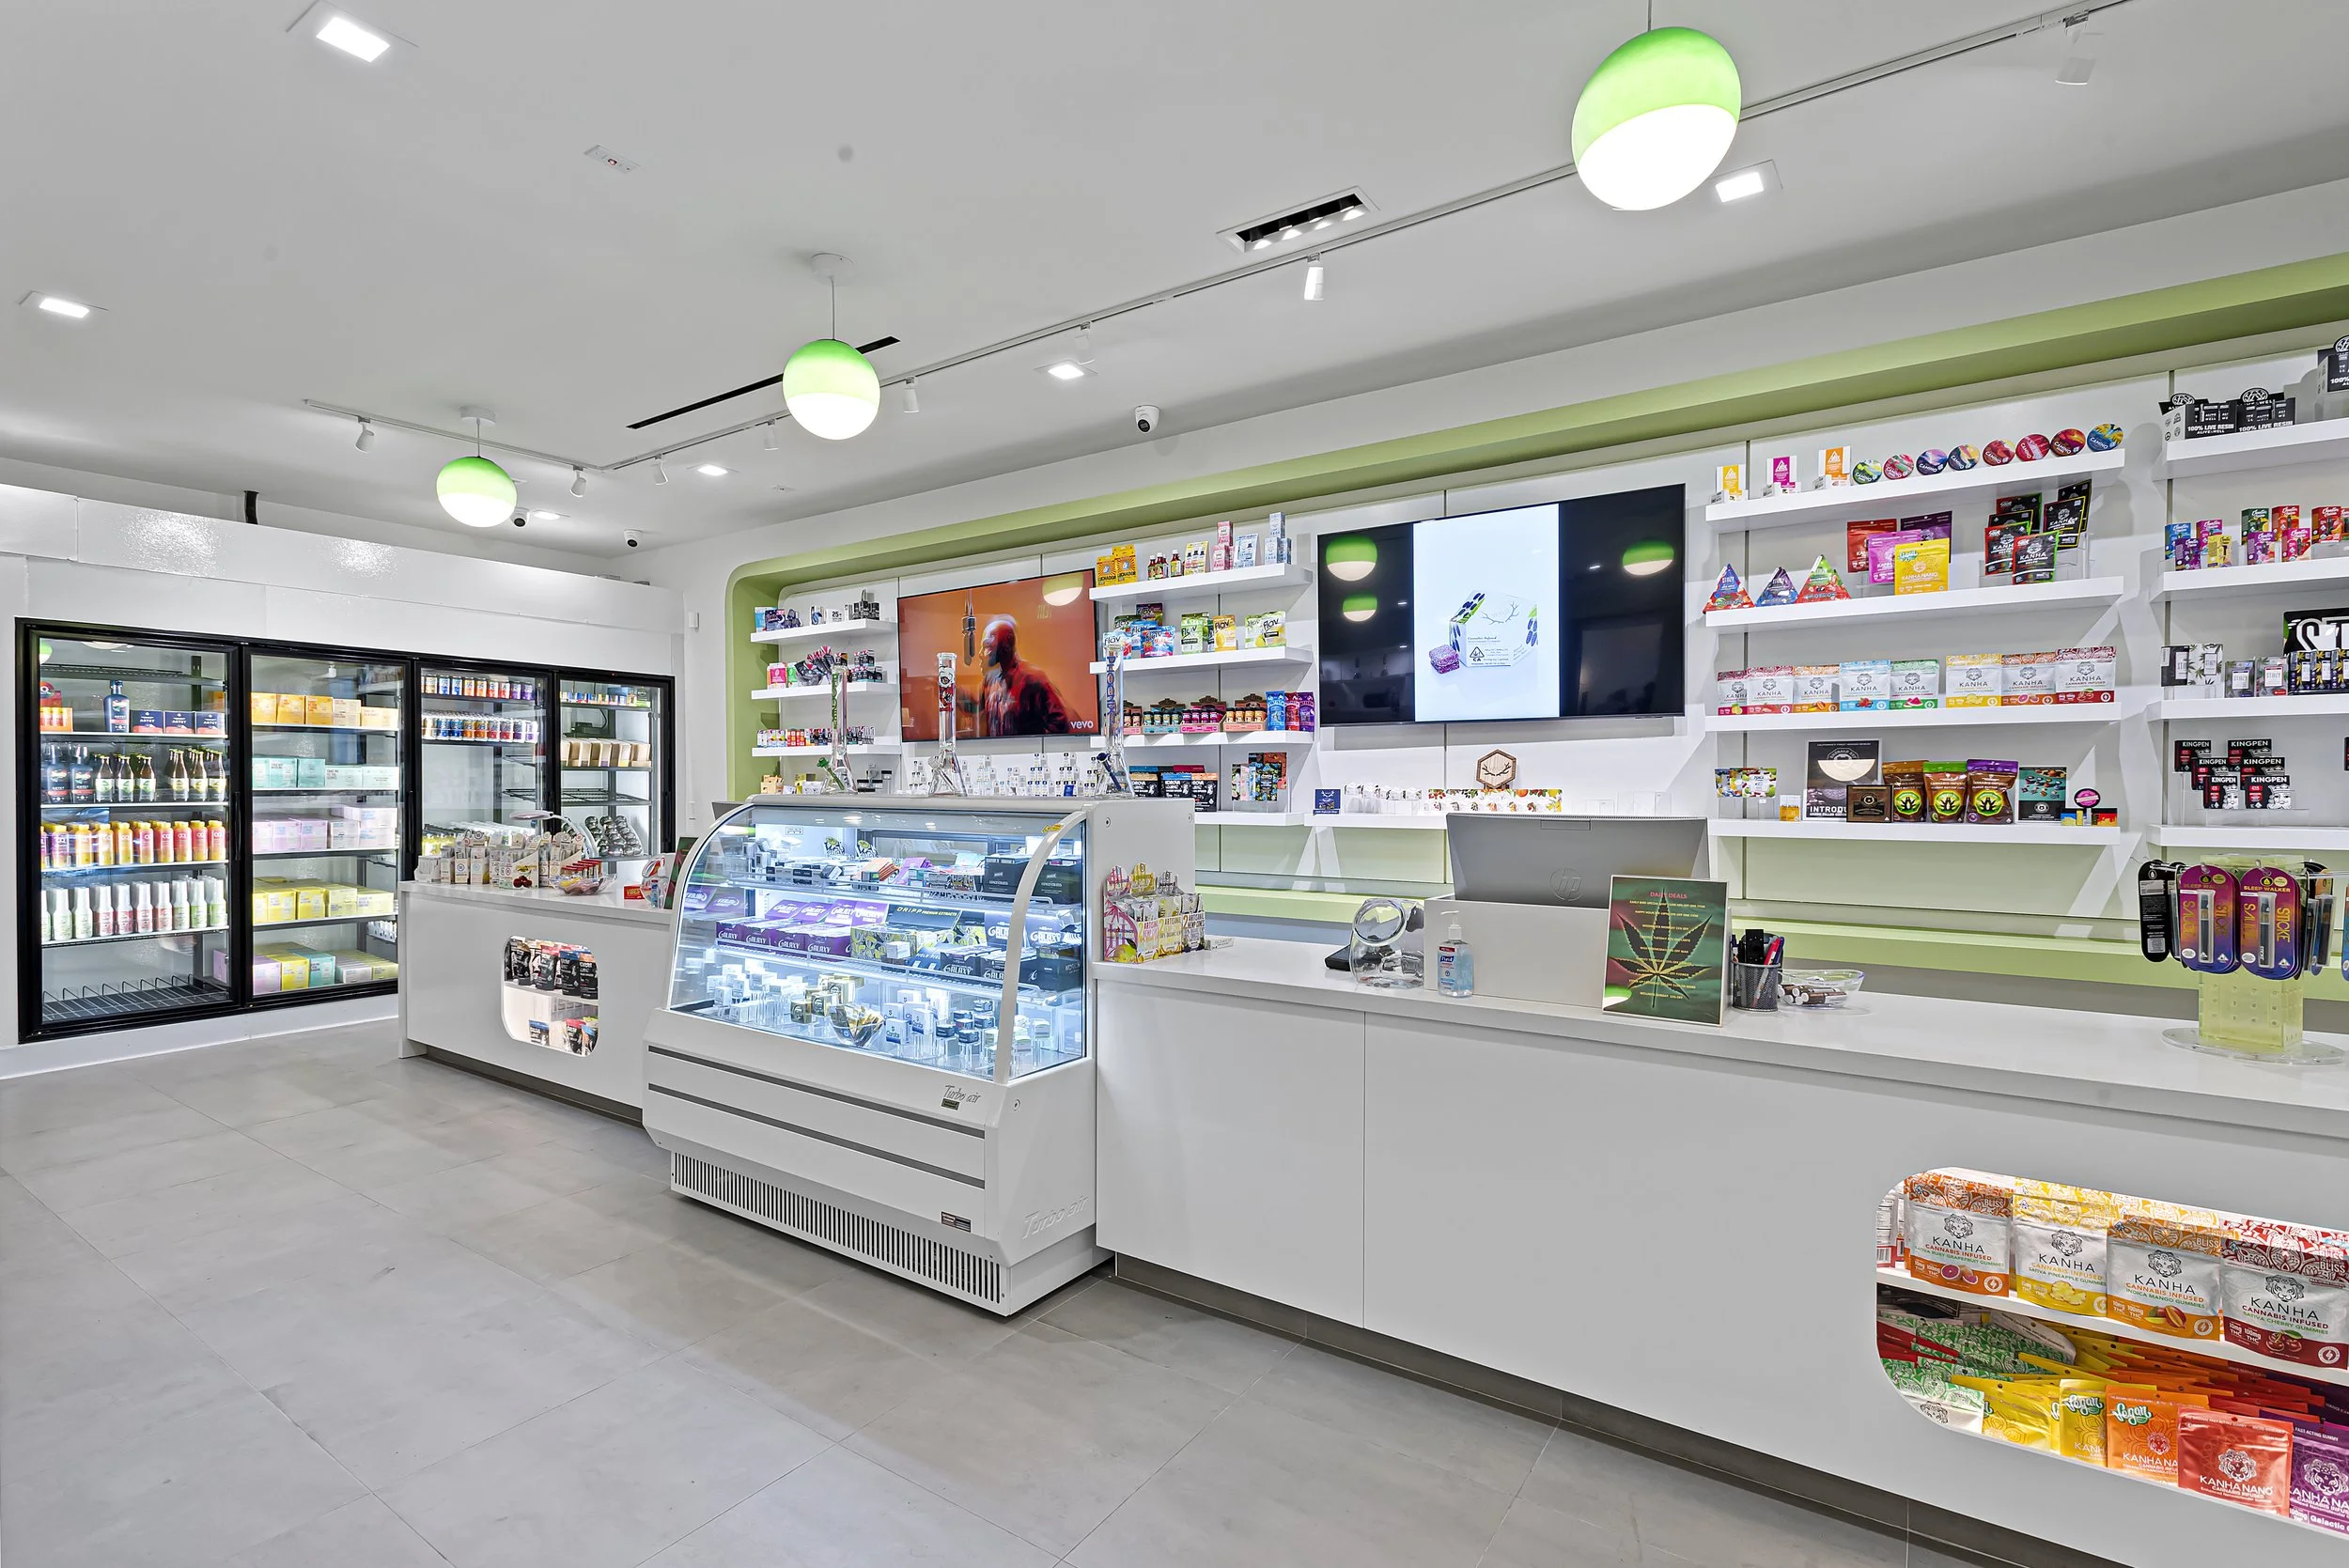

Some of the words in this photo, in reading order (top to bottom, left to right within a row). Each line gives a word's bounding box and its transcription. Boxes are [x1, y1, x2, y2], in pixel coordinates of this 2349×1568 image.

[2020, 442, 2031, 458] CAMINO
[2054, 442, 2072, 455] CAMINO
[2090, 437, 2108, 449] CAMINO
[1951, 455, 1965, 469] CAMINO
[1984, 451, 2001, 464] CAMINO
[1919, 464, 1937, 473] CAMINO
[1855, 472, 1873, 482] CAMINO
[1069, 720, 1094, 730] vevo
[988, 926, 1009, 939] GALA
[2277, 908, 2291, 943] STICKE
[718, 930, 739, 939] GALAXY
[778, 939, 801, 949] GALAXY
[807, 943, 832, 953] GALAXY
[943, 964, 972, 975] GALAXY
[985, 970, 1004, 980] GALA
[943, 1084, 966, 1101] Turbo
[966, 1093, 981, 1104] air
[1983, 1198, 2004, 1209] BLISS
[1022, 1211, 1066, 1240] Turbo
[1067, 1195, 1089, 1218] air
[1932, 1235, 1985, 1254] KANHA
[2197, 1237, 2219, 1249] BLISS
[1924, 1244, 1960, 1257] CANNABIS
[1961, 1250, 1992, 1261] INFUSED
[2039, 1253, 2095, 1273] KANHA
[2320, 1260, 2346, 1274] BLISS
[2031, 1262, 2069, 1276] CANNABIS
[2071, 1269, 2103, 1281] INFUSED
[2047, 1270, 2079, 1282] PINEAPPLE
[2135, 1274, 2196, 1296] KANHA
[2125, 1282, 2167, 1296] CANNABIS
[2169, 1291, 2204, 1303] INFUSED
[2125, 1287, 2147, 1298] INDICA
[2148, 1293, 2174, 1304] MANGO
[2175, 1298, 2205, 1309] GUMMIES
[2250, 1296, 2319, 1321] KANHA
[2242, 1304, 2287, 1321] CANNABIS
[2289, 1317, 2328, 1329] INFUSED
[2266, 1317, 2295, 1328] CHERRY
[2295, 1323, 2329, 1335] GUMMIES
[2244, 1327, 2262, 1341] 100mg
[2075, 1442, 2105, 1454] KANH
[2123, 1452, 2161, 1466] KANHA
[2163, 1459, 2178, 1467] NA
[2200, 1475, 2242, 1491] KANHA
[2242, 1483, 2272, 1495] NANO
[2331, 1498, 2349, 1510] NA
[2310, 1514, 2345, 1530] Galactic
